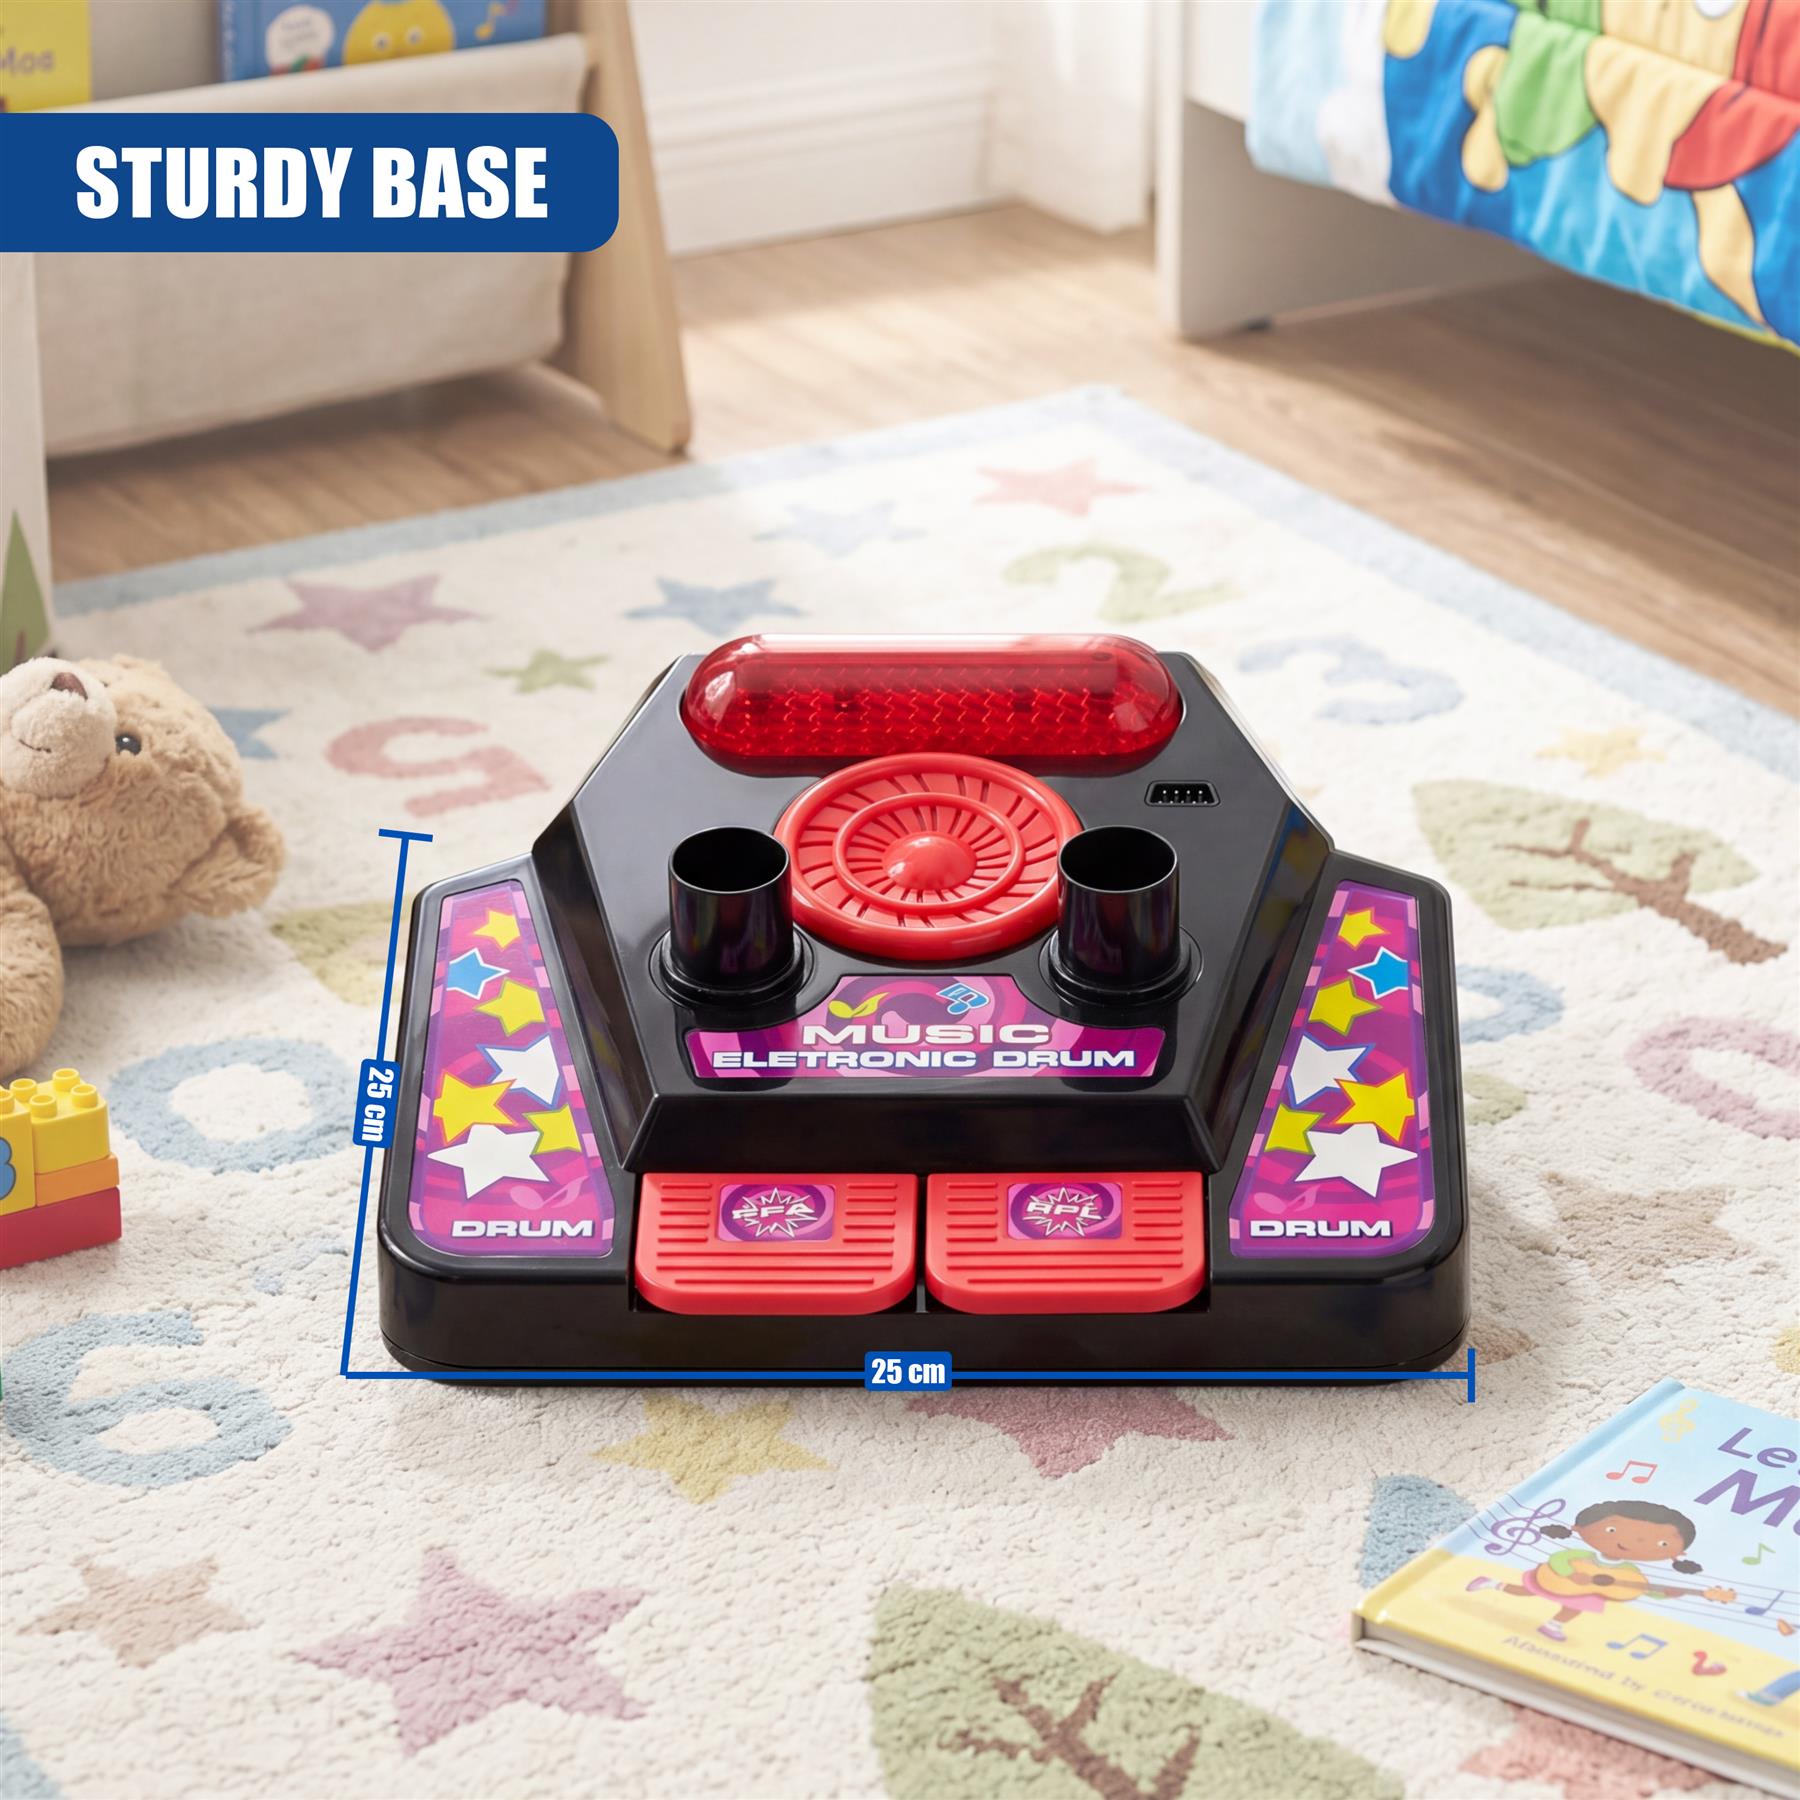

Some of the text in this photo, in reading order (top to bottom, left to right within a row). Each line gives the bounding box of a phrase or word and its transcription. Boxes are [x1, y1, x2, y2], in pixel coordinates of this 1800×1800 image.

[801, 1023, 1051, 1046] MUSIC
[712, 1049, 1136, 1070] ELETRONIC DRUM
[451, 1219, 595, 1238] DRUM
[1249, 1219, 1393, 1238] DRUM
[1717, 1426, 1800, 1475] Le
[1693, 1468, 1800, 1536] M
